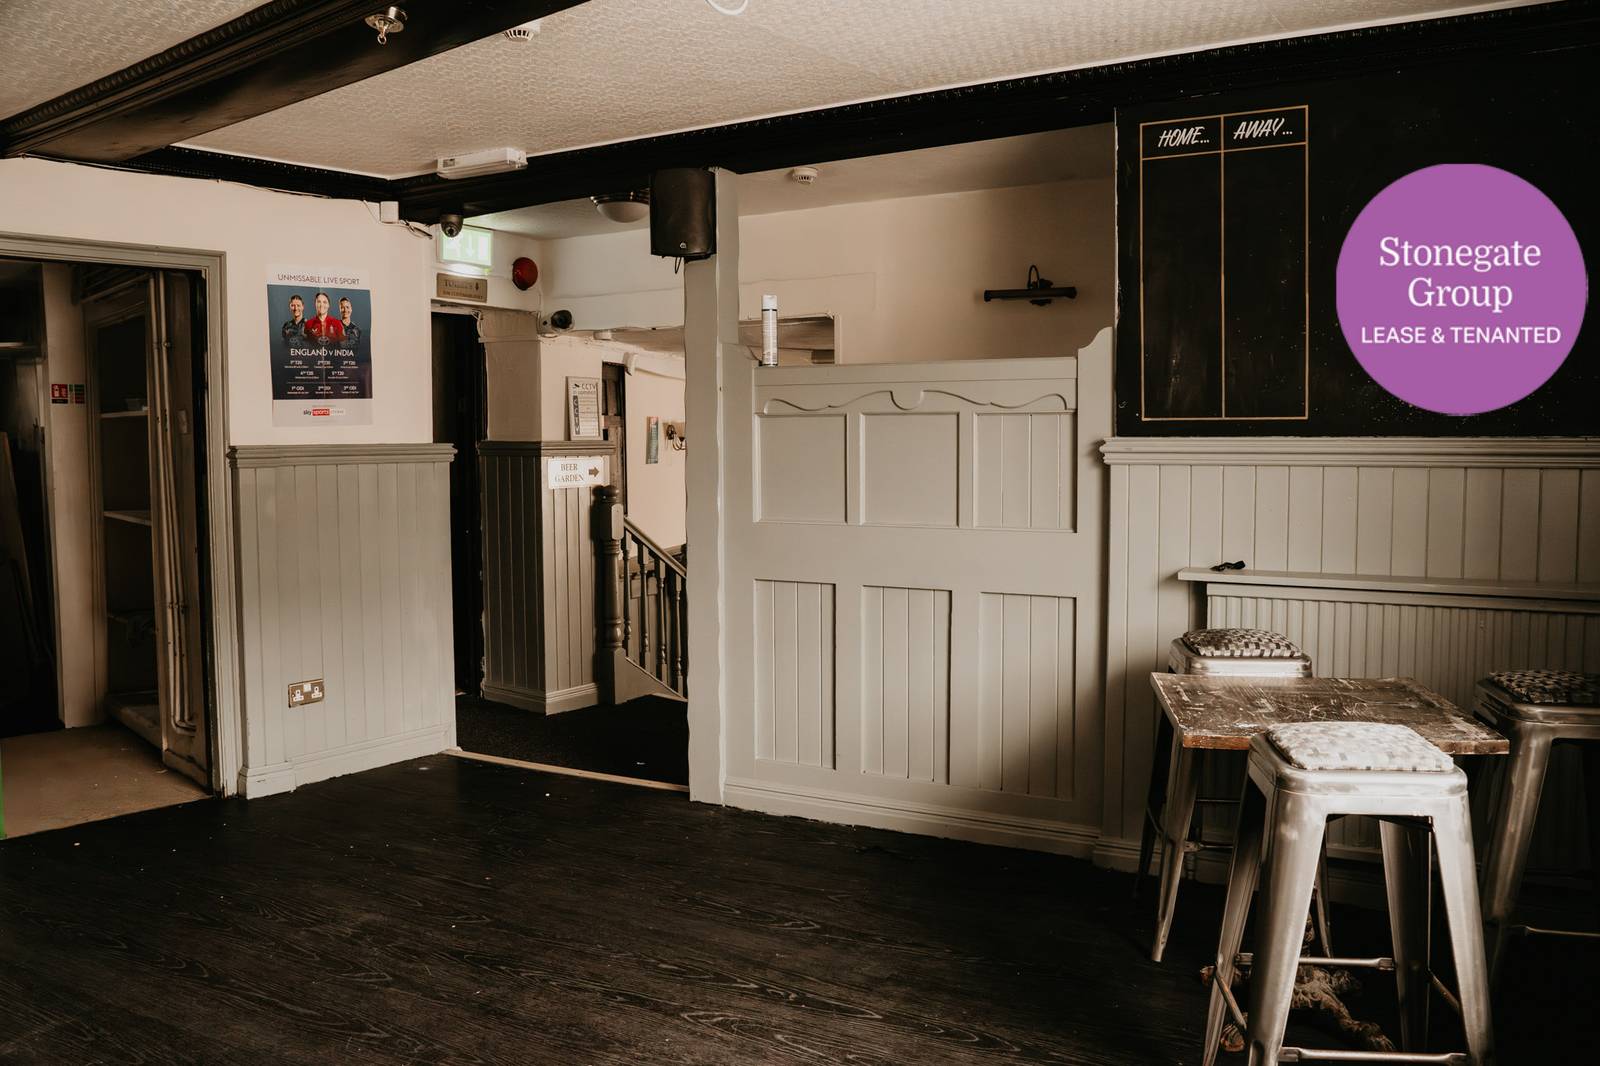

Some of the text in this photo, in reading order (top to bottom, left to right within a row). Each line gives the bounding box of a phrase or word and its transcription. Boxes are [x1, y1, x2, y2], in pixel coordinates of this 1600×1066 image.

[1233, 118, 1293, 140] AWAY...
[1158, 126, 1210, 148] HOME...
[277, 274, 321, 284] UNMISSABLE
[339, 277, 360, 285] SPORT
[290, 347, 328, 357] ENGLAND
[334, 349, 354, 357] INDIA
[560, 463, 578, 471] BEER
[554, 474, 584, 482] GARDEN
